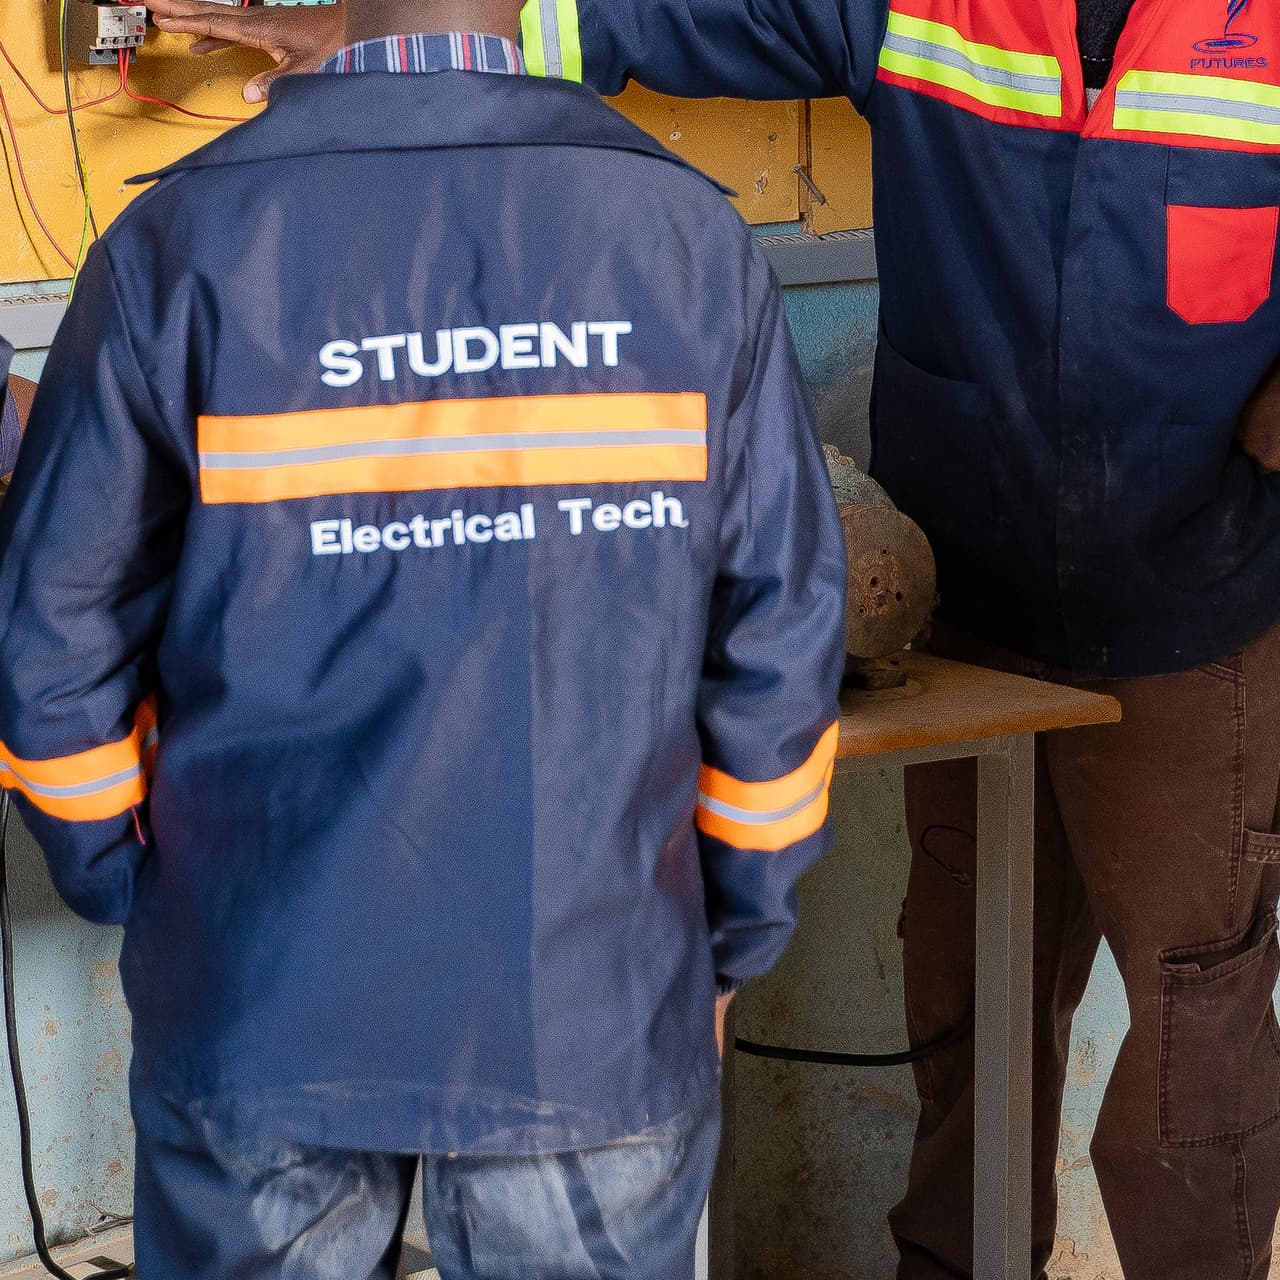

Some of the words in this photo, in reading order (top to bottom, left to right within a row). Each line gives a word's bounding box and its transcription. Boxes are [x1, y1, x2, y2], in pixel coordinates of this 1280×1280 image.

[1190, 56, 1269, 70] FUTURES
[318, 320, 633, 388] STUDENT
[309, 503, 536, 556] Electrical
